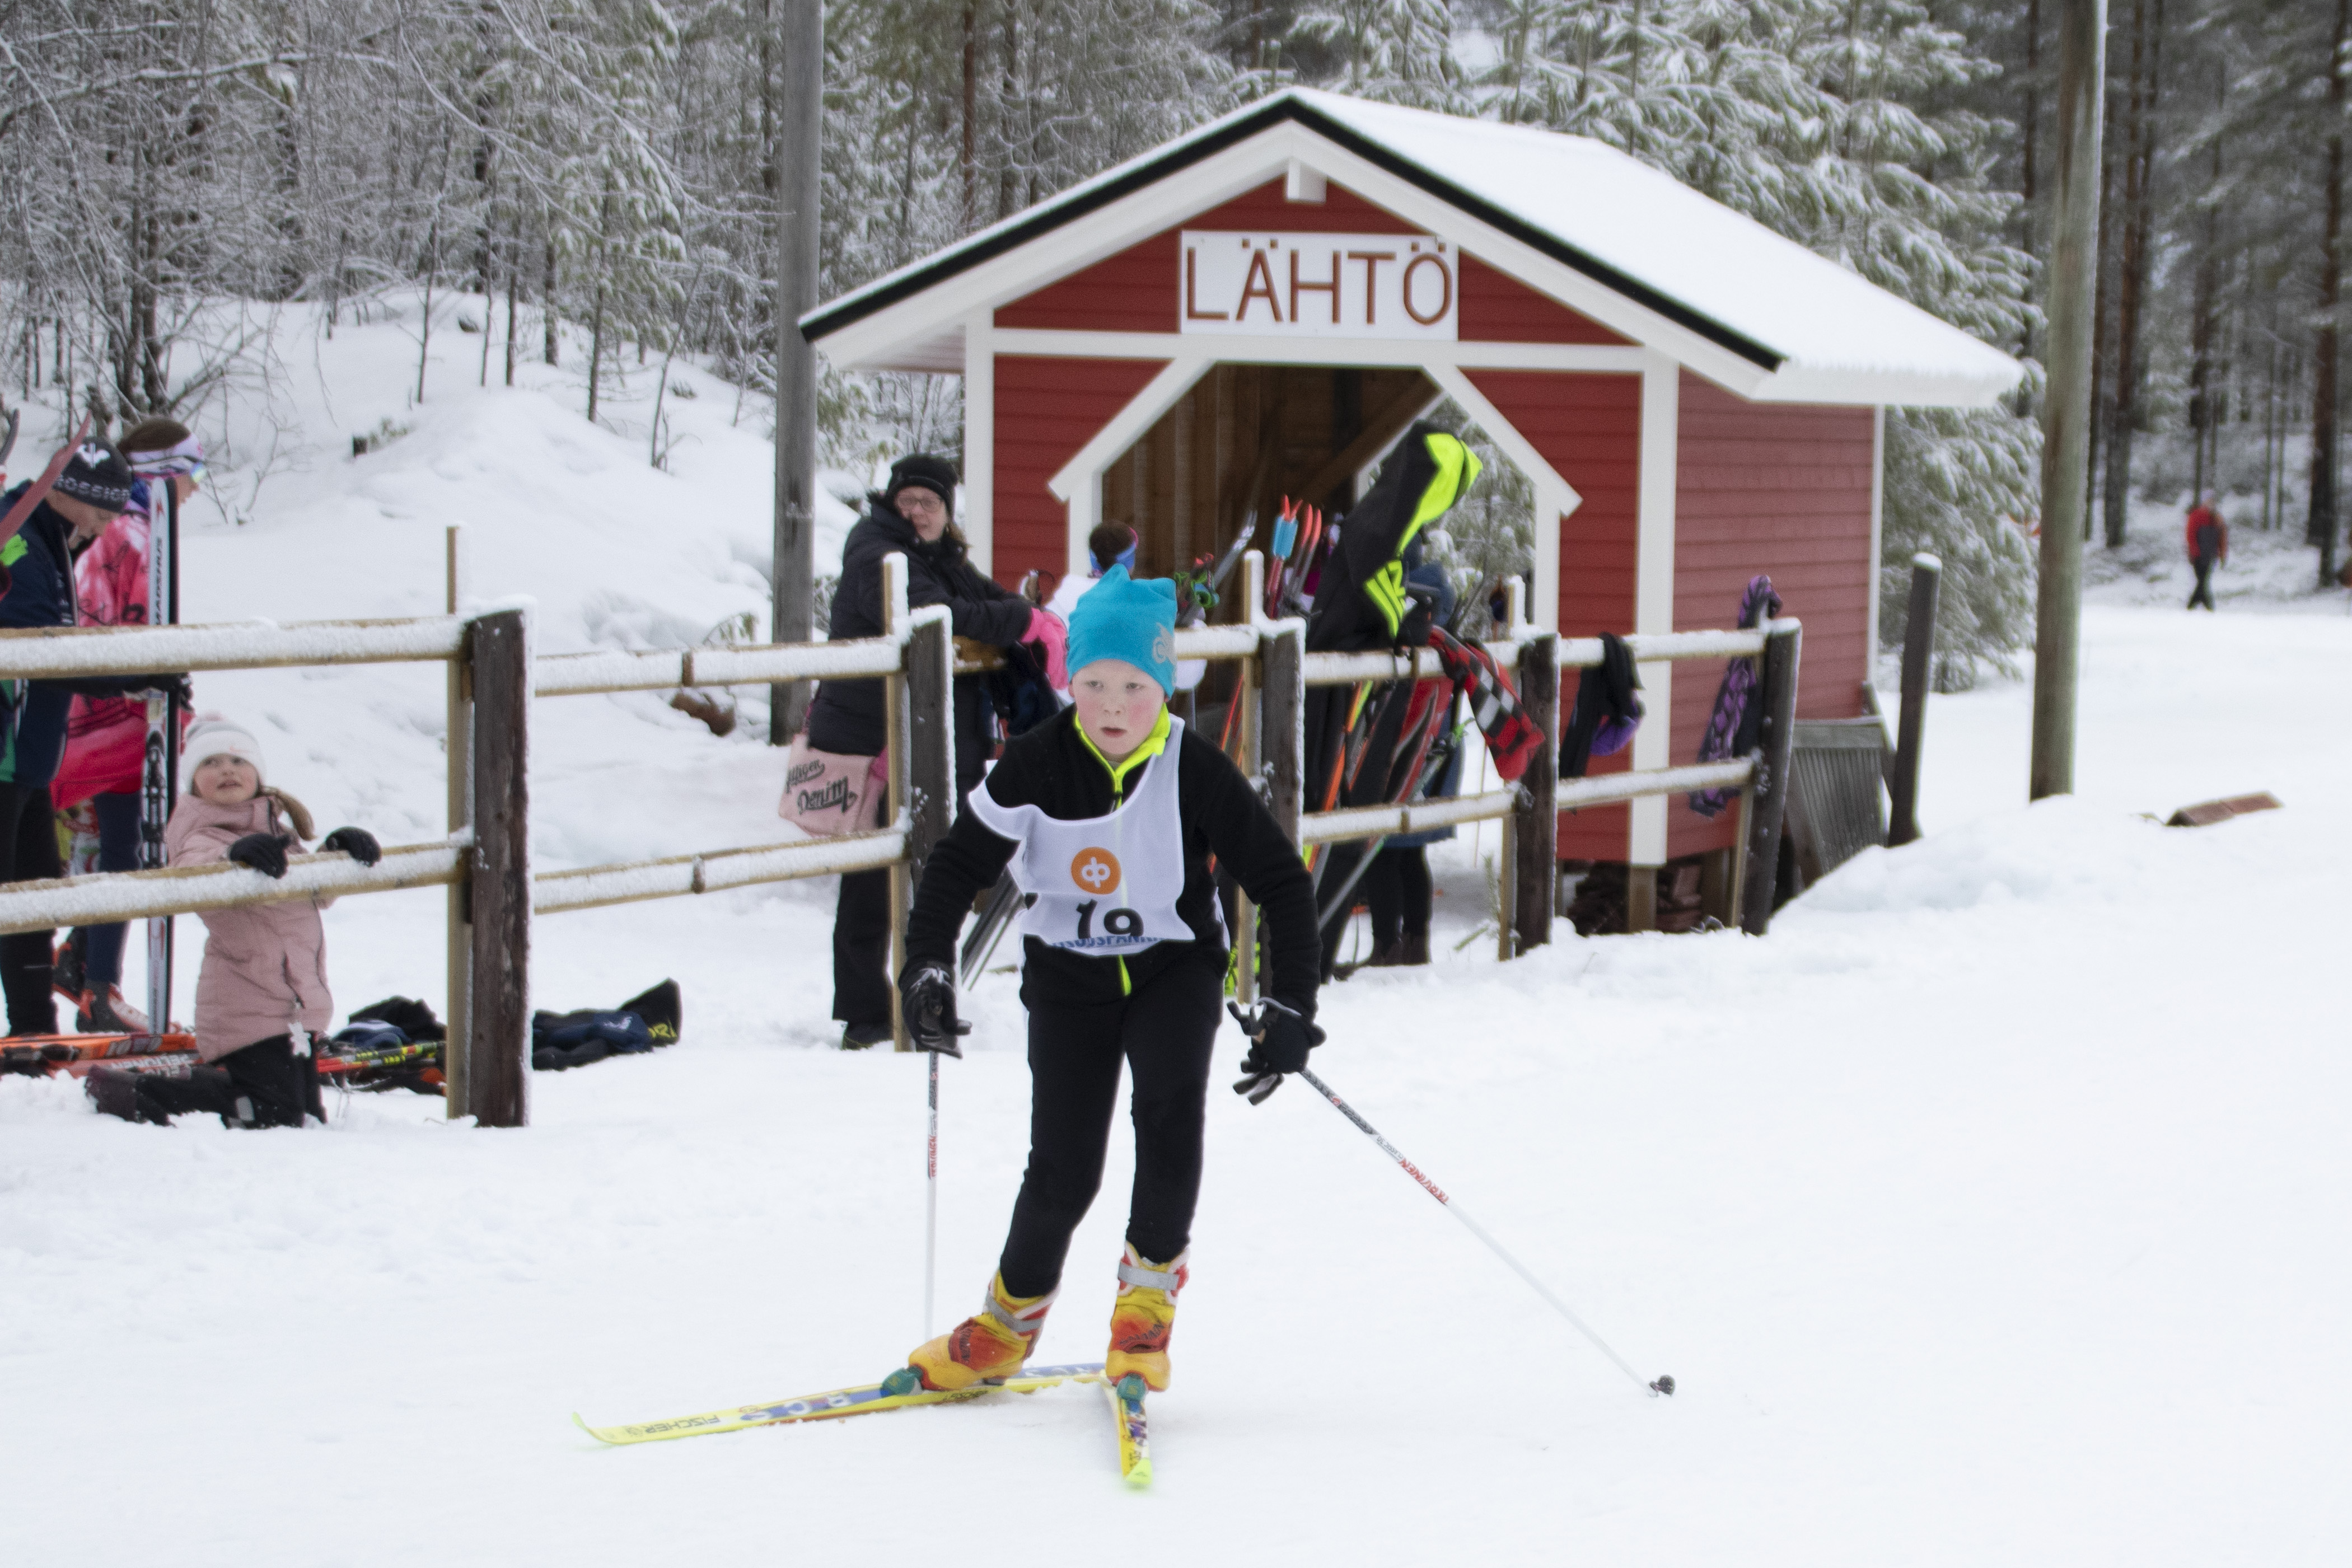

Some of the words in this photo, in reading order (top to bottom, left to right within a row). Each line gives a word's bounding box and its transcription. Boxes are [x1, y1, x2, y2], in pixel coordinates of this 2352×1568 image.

[1187, 238, 1453, 326] LÄHTÖ
[1076, 898, 1144, 939] 19
[644, 1414, 721, 1434] FISCHER
